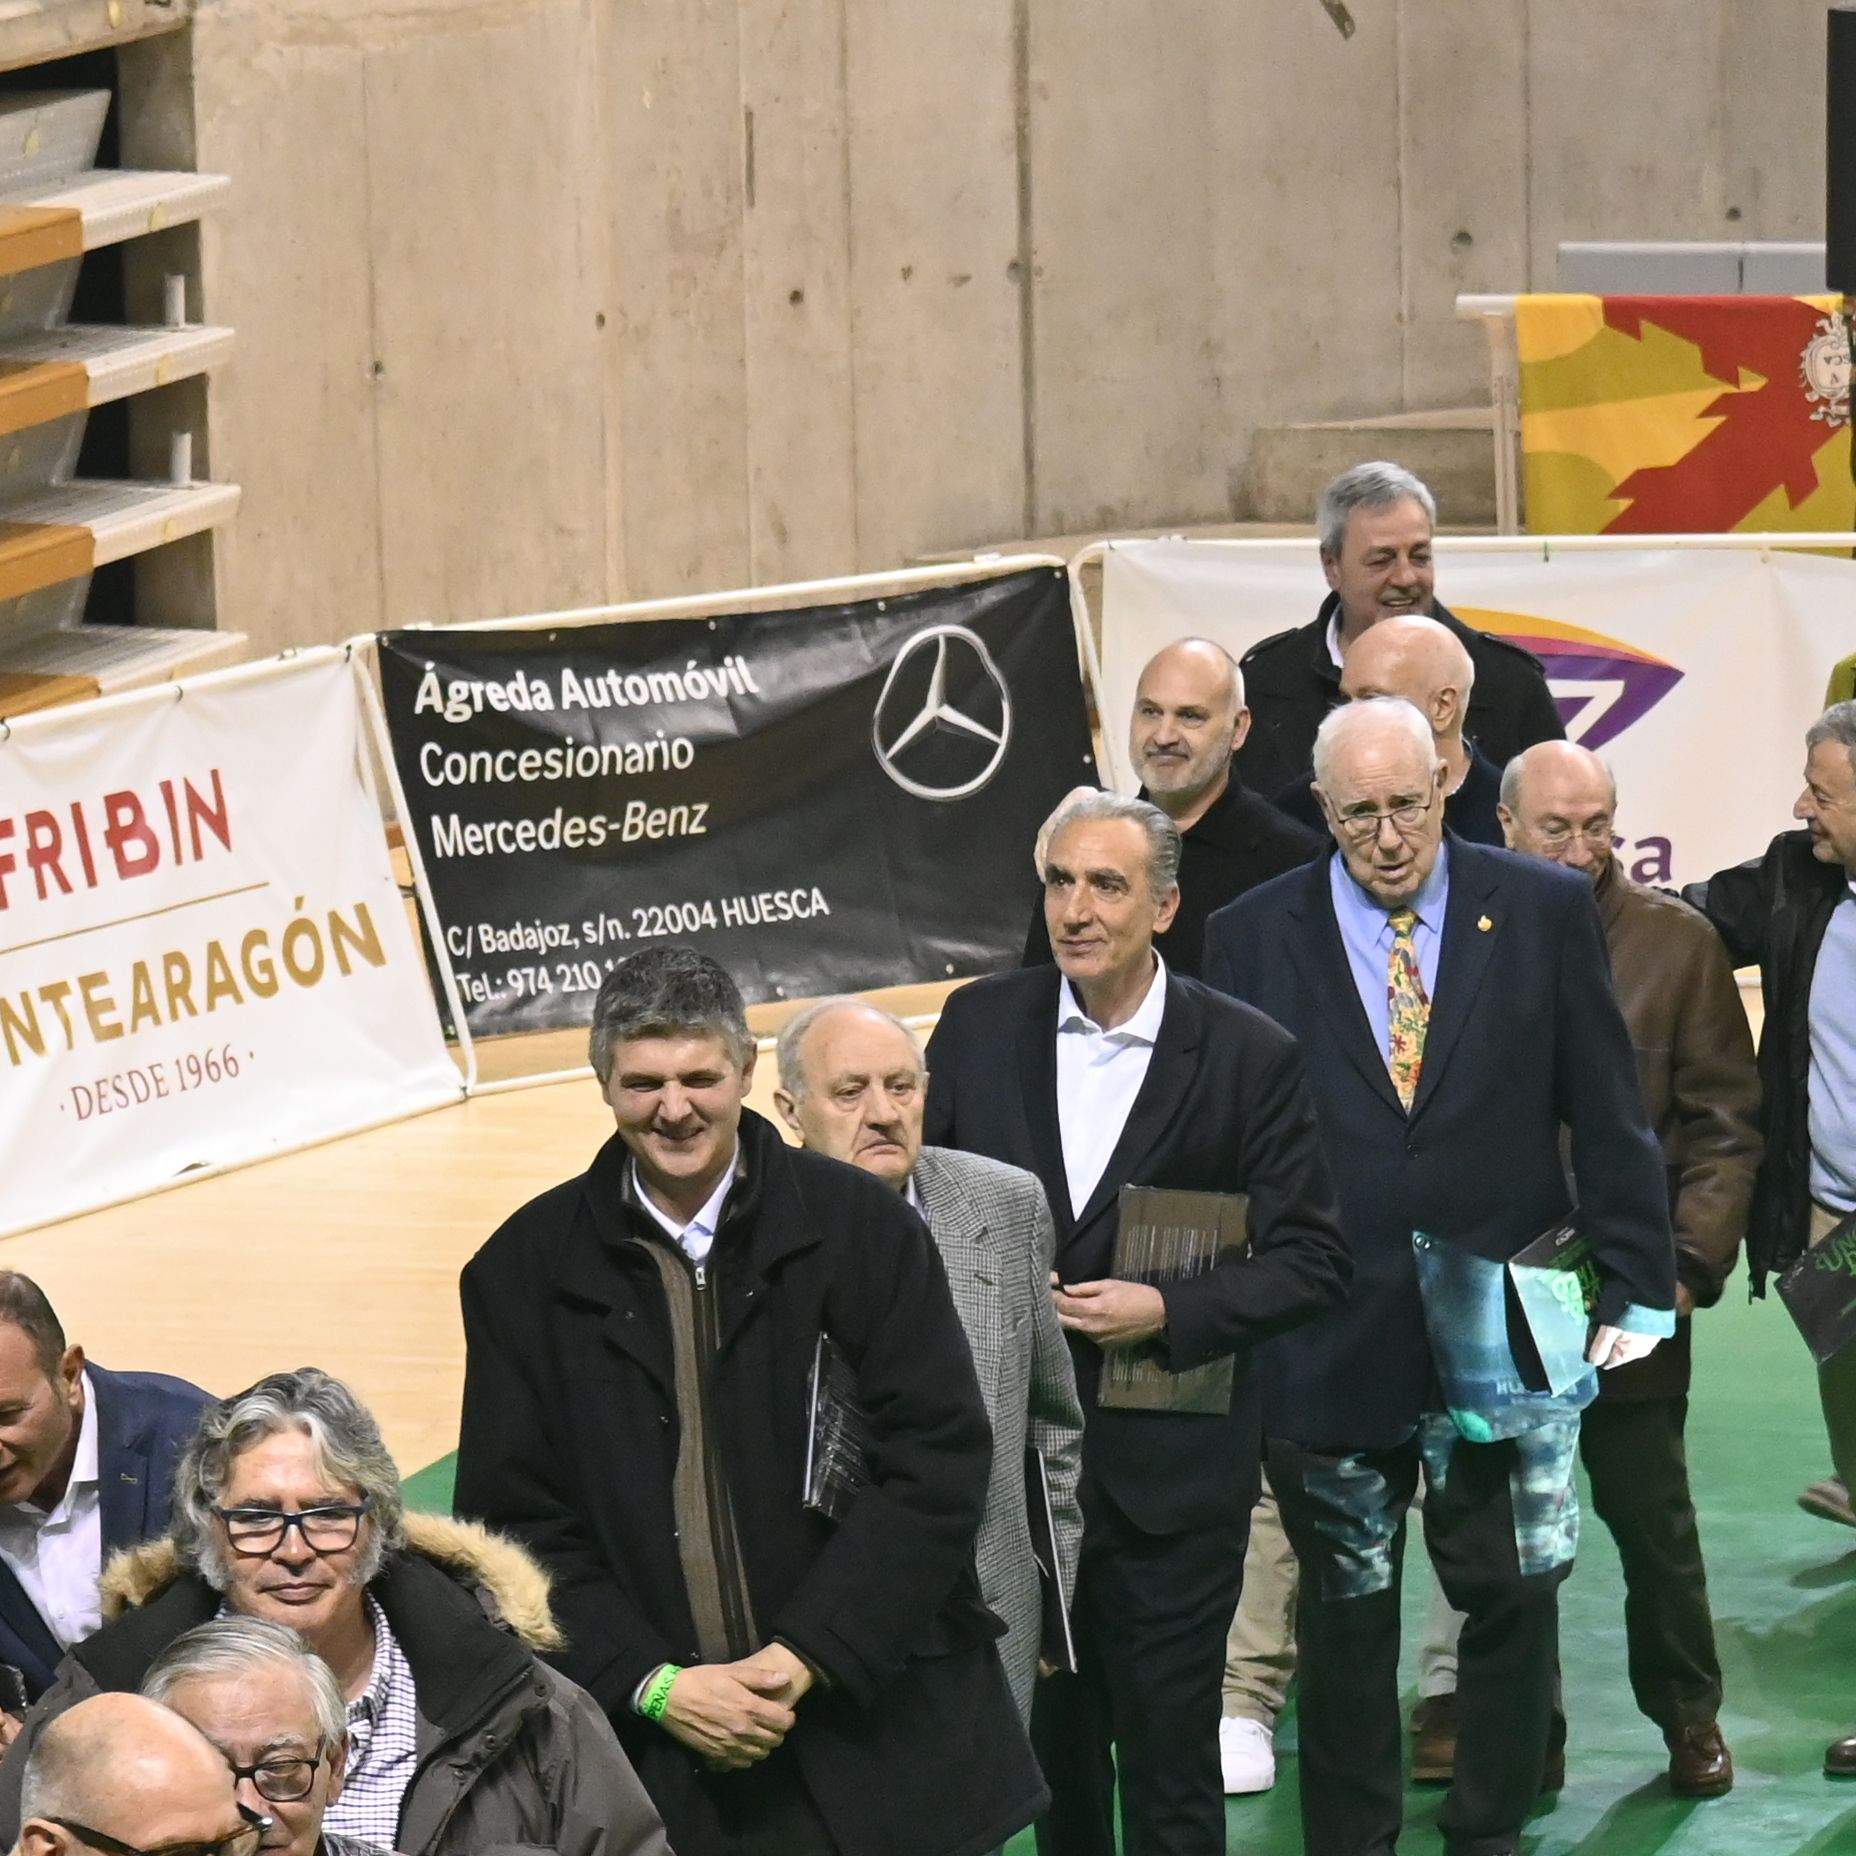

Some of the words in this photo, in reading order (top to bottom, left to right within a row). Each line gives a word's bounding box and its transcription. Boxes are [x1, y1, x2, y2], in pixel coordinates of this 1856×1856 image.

[414, 661, 554, 723] Ágreda
[561, 655, 760, 711] Automóvil
[420, 730, 694, 787] Concesionario
[431, 801, 710, 859] Mercedes-Benz
[447, 924, 473, 959] C/
[480, 919, 580, 956] Badajoz,
[584, 912, 630, 947] s/n.
[632, 901, 718, 938] 22004
[721, 886, 831, 928] HUESCA
[507, 966, 553, 998] 974
[557, 960, 602, 993] 210
[71, 1062, 169, 1121] DESDE
[174, 1044, 240, 1093] 1966
